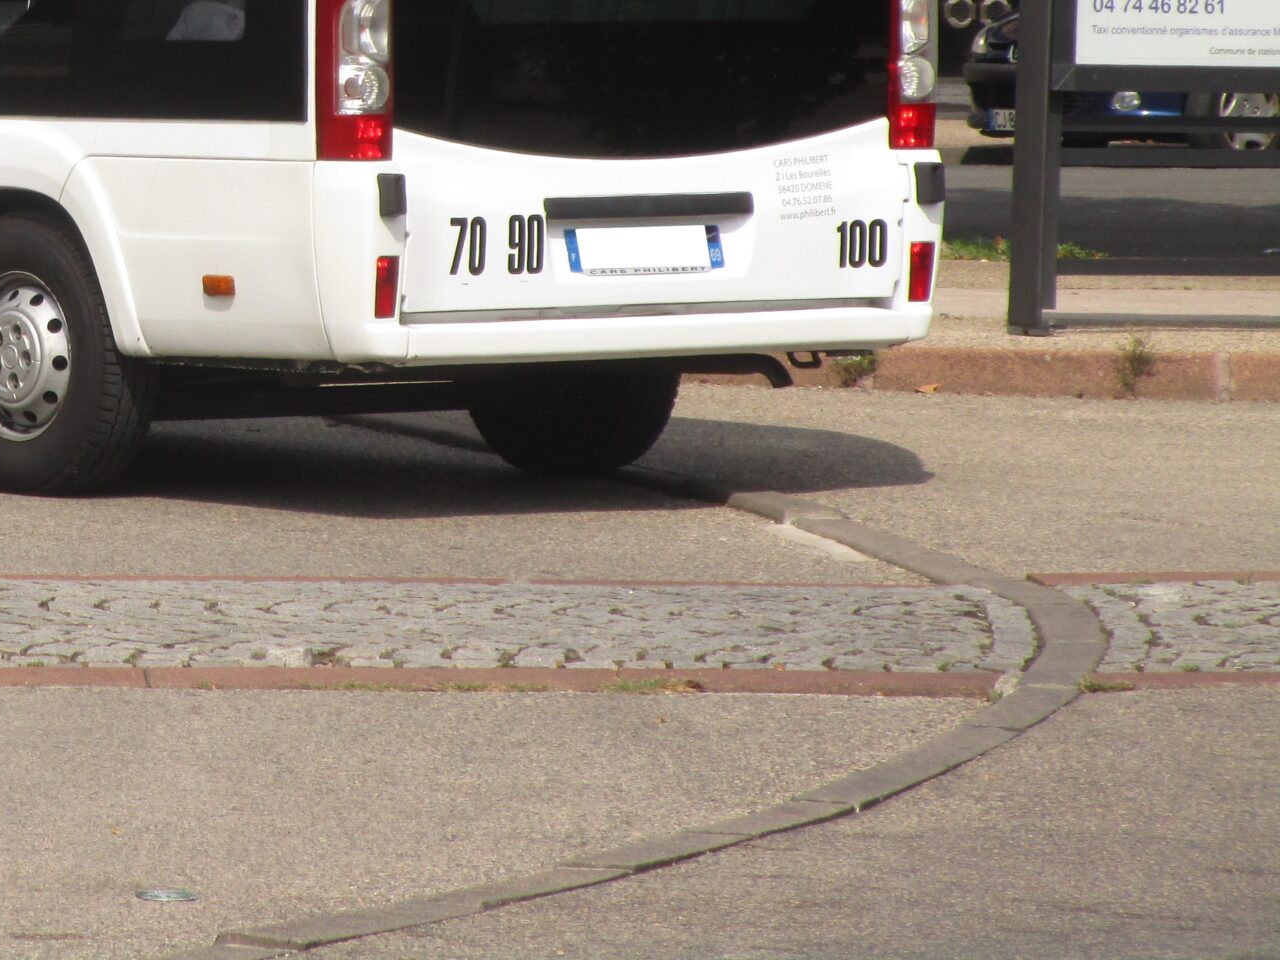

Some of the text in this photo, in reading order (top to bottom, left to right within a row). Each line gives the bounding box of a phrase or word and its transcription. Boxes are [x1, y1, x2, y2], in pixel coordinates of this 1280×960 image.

[1091, 24, 1109, 35] Taxi
[1170, 26, 1218, 38] organismes
[1210, 46, 1245, 55] Commune
[1247, 47, 1256, 56] de
[449, 214, 545, 276] 70 90
[837, 219, 888, 268] 100
[589, 265, 707, 275] CARS PHILIBERT
